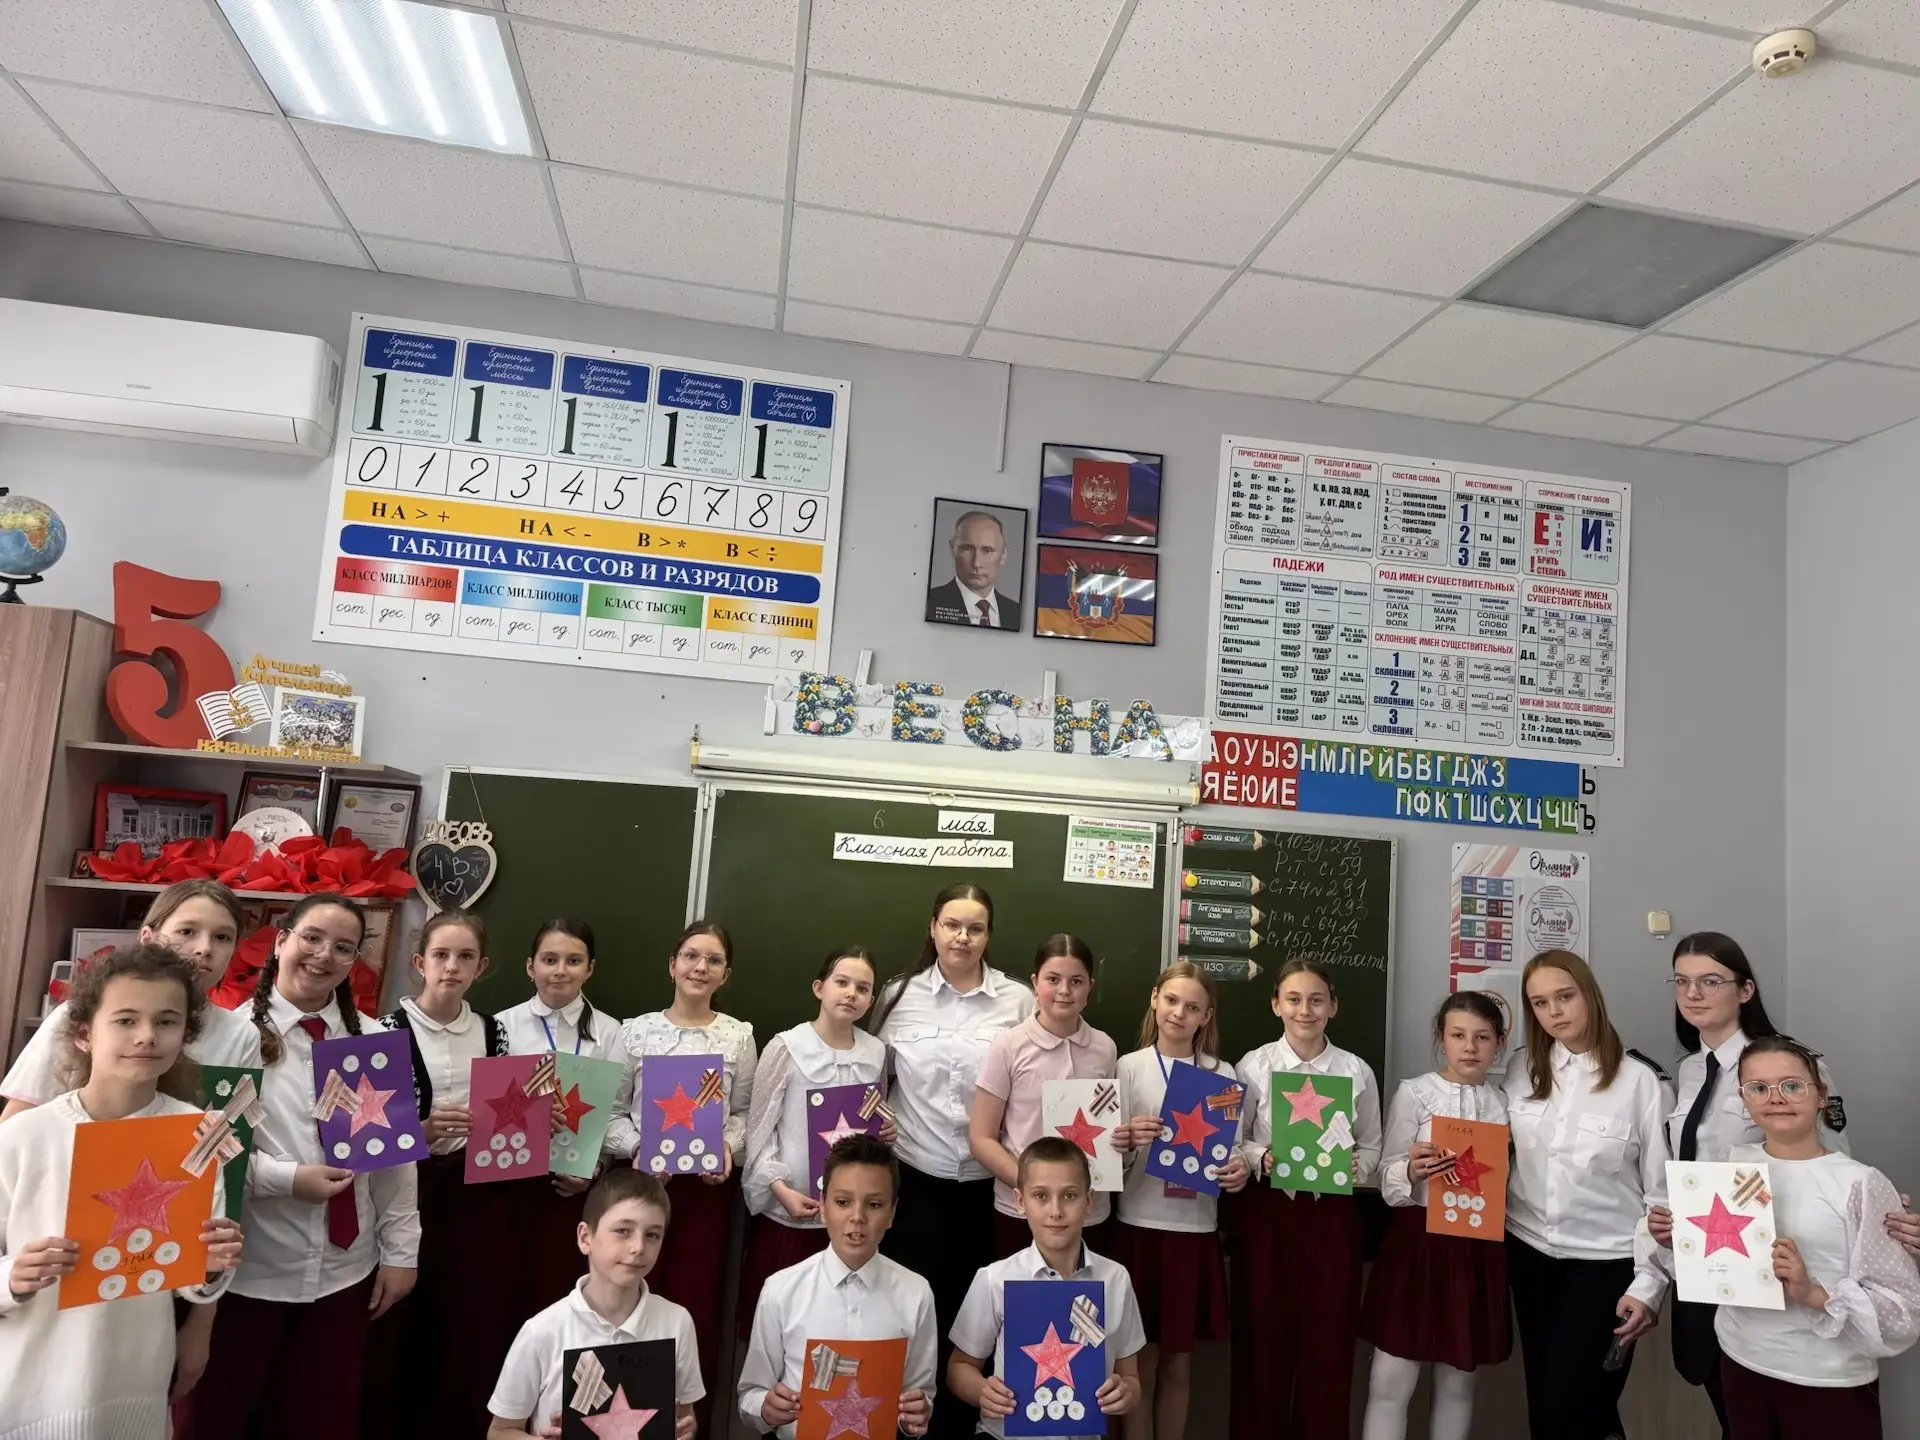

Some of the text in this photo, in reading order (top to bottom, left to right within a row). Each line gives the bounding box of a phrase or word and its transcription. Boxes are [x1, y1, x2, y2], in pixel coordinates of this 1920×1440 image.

[389, 334, 435, 349] Единицы
[383, 348, 438, 360] измерения
[488, 347, 532, 362] Единицы
[391, 358, 426, 368] длины
[482, 360, 536, 373] измерения
[585, 361, 629, 376] Единицы
[490, 371, 524, 381] массы
[580, 373, 633, 387] измерения
[680, 374, 723, 389] Единицы
[366, 372, 387, 431] 1
[675, 386, 726, 401] измерения
[773, 387, 814, 402] Единицы
[668, 395, 732, 412] площади (S)
[768, 400, 817, 413] измерения
[465, 384, 485, 443] 1
[801, 411, 817, 423] (V)
[558, 397, 577, 455] 1
[660, 410, 679, 469] 1
[750, 423, 769, 480] 1
[1238, 449, 1300, 463] ПРИСТАВКИ ПИШИ
[358, 446, 387, 483] 0
[415, 452, 437, 487] 1
[1253, 461, 1283, 471] СЛИТНО!
[1314, 458, 1372, 471] ПРЕДЛОГИ ПИШИ
[458, 457, 489, 494] 2
[510, 463, 537, 499] 3
[1323, 468, 1361, 479] ОТДЕЛЬНО!
[1392, 472, 1441, 484] СОСТАВ СЛОВА
[560, 469, 585, 506] 4
[604, 475, 638, 510] 5
[1465, 480, 1513, 492] МЕСТОИМЕНИЯ
[656, 482, 683, 517] 6
[703, 486, 730, 522] 7
[1538, 489, 1610, 504] СПРЯЖЕНИЕ ГЛАГОЛОВ
[749, 493, 773, 528] 8
[792, 499, 818, 533] 9
[1460, 503, 1469, 522] 1
[1229, 522, 1290, 537] обход подход
[1459, 525, 1470, 544] 2
[1533, 511, 1550, 546] Е
[1581, 517, 1602, 552] И
[1228, 532, 1296, 546] зашел перешел
[388, 535, 779, 594] ТАБЛИЦА КЛАССОВ И РАЗРЯДОВ
[1458, 547, 1469, 566] 3
[1537, 556, 1559, 566] БРИТЬ
[1272, 557, 1325, 573] ПАДЕЖИ
[1536, 566, 1567, 577] СТЕЛИТЬ
[342, 570, 452, 590] КЛАСС МИЛЛИАРДОВ
[1379, 570, 1515, 592] РОД ИМЕН СУЩЕСТВИТЕЛЬНЫХ
[467, 582, 579, 605] КЛАСС МИЛЛИОНОВ
[1532, 584, 1608, 601] ОКОНЧАНИЕ ИМЕН
[605, 596, 687, 615] КЛАСС ТЫСЯЧ
[1386, 602, 1409, 611] ПАПА
[1527, 593, 1612, 611] СУЩЕСТВИТЕЛЬНЫХ
[713, 608, 814, 630] КЛАСС ЕДИНИЦ
[1386, 611, 1409, 619] ОРЕХ
[1433, 607, 1459, 616] МАМА
[1434, 615, 1457, 624] ЗАРЯ
[1477, 611, 1511, 621] СОЛНЦЕ
[1385, 619, 1408, 627] ВОЛК
[1434, 623, 1456, 632] ИГРА
[1479, 620, 1508, 629] СЛОВО
[1479, 628, 1508, 637] ВРЕМЯ
[1374, 633, 1417, 645] СКЛОНЕНИЕ
[1419, 637, 1440, 647] ИМЕН
[1441, 639, 1514, 654] СУЩЕСТВИТЕЛЬНЫХ
[106, 560, 236, 750] 5
[1392, 652, 1400, 667] 1
[252, 653, 321, 677] Лучшей
[1374, 667, 1415, 678] СКЛОНЕНИЕ
[240, 664, 353, 698] Учительнице
[1390, 680, 1399, 696] 2
[1373, 695, 1414, 707] СКЛОНЕНИЕ
[1519, 697, 1613, 715] МЯГКИЙ ЗНАК ПОСЛЕ ШИПЯЩИХ
[793, 671, 1175, 762] ВЕСНА
[1388, 708, 1398, 724] 3
[1372, 724, 1413, 736] СКЛОНЕНИЕ
[1582, 768, 1596, 795] Ь
[873, 809, 886, 829] 6
[1580, 803, 1596, 831] Ъ
[836, 836, 927, 858] Классная
[434, 853, 443, 880] 4
[1204, 963, 1224, 972] ИЗО
